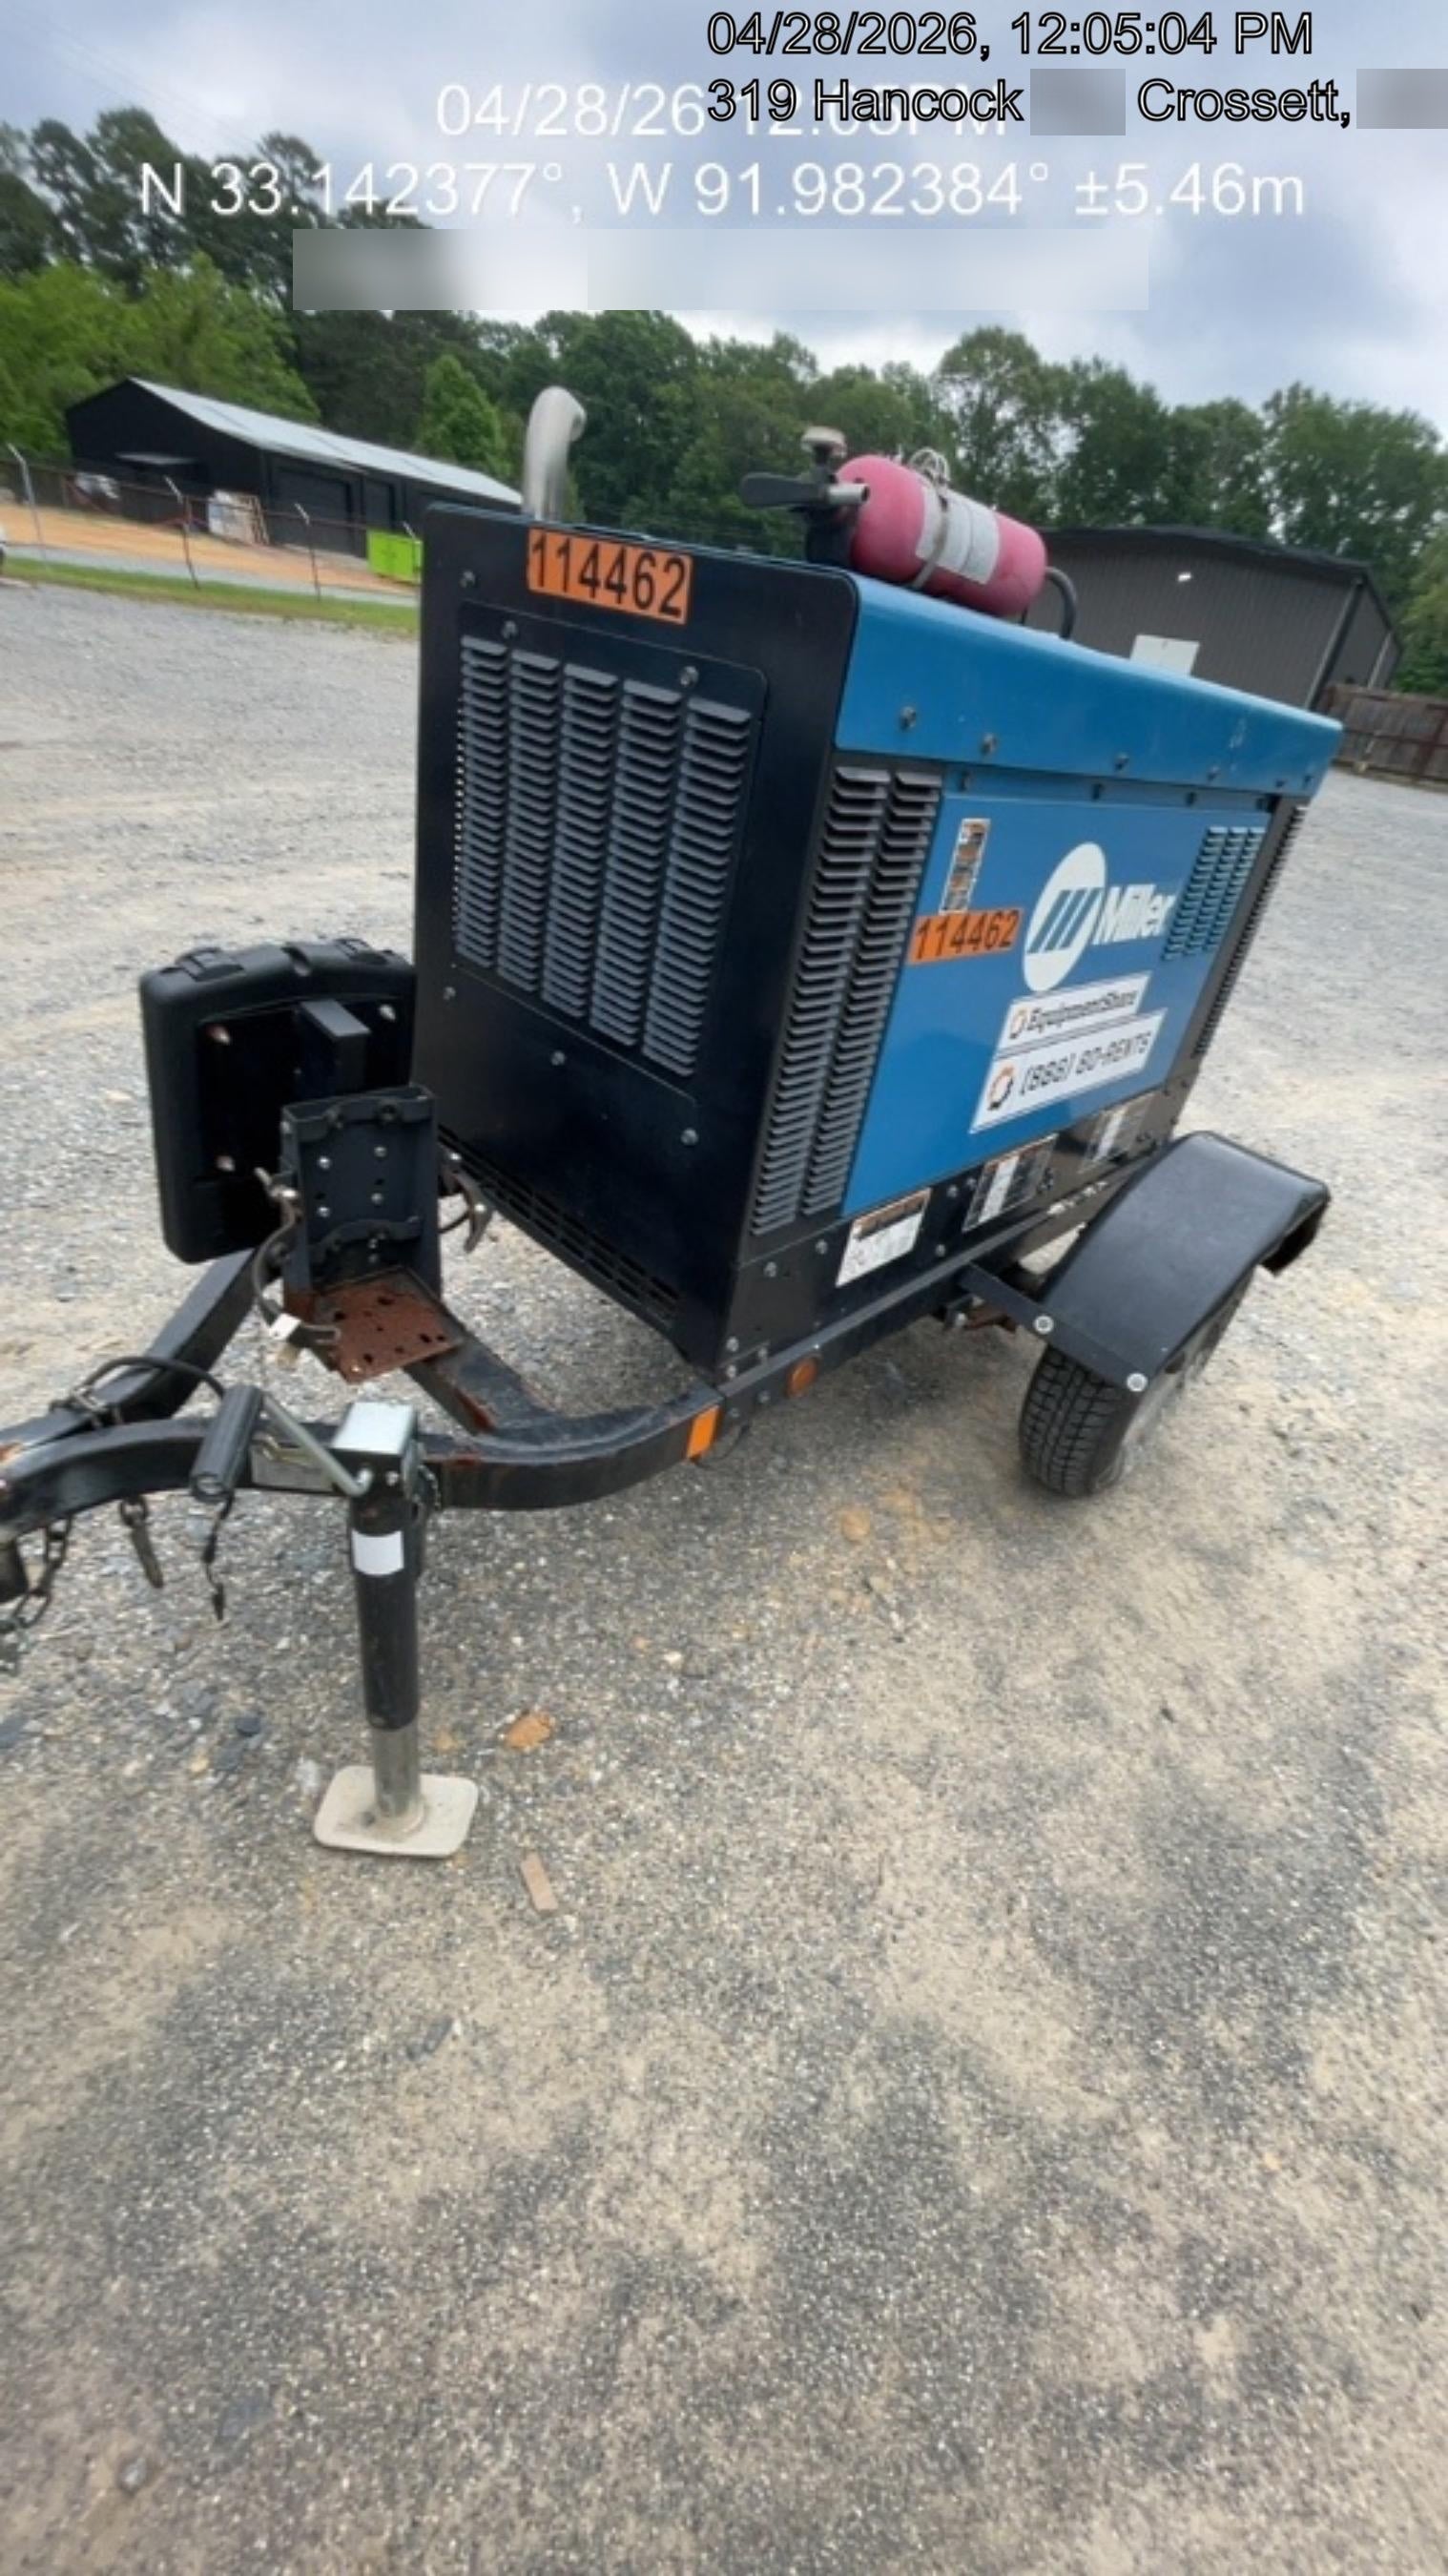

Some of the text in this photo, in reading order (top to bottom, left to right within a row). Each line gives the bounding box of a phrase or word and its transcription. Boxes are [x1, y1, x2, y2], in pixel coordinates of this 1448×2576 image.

[531, 531, 686, 618] 114462
[914, 908, 1020, 960] 114462
[1091, 883, 1178, 945] Miller
